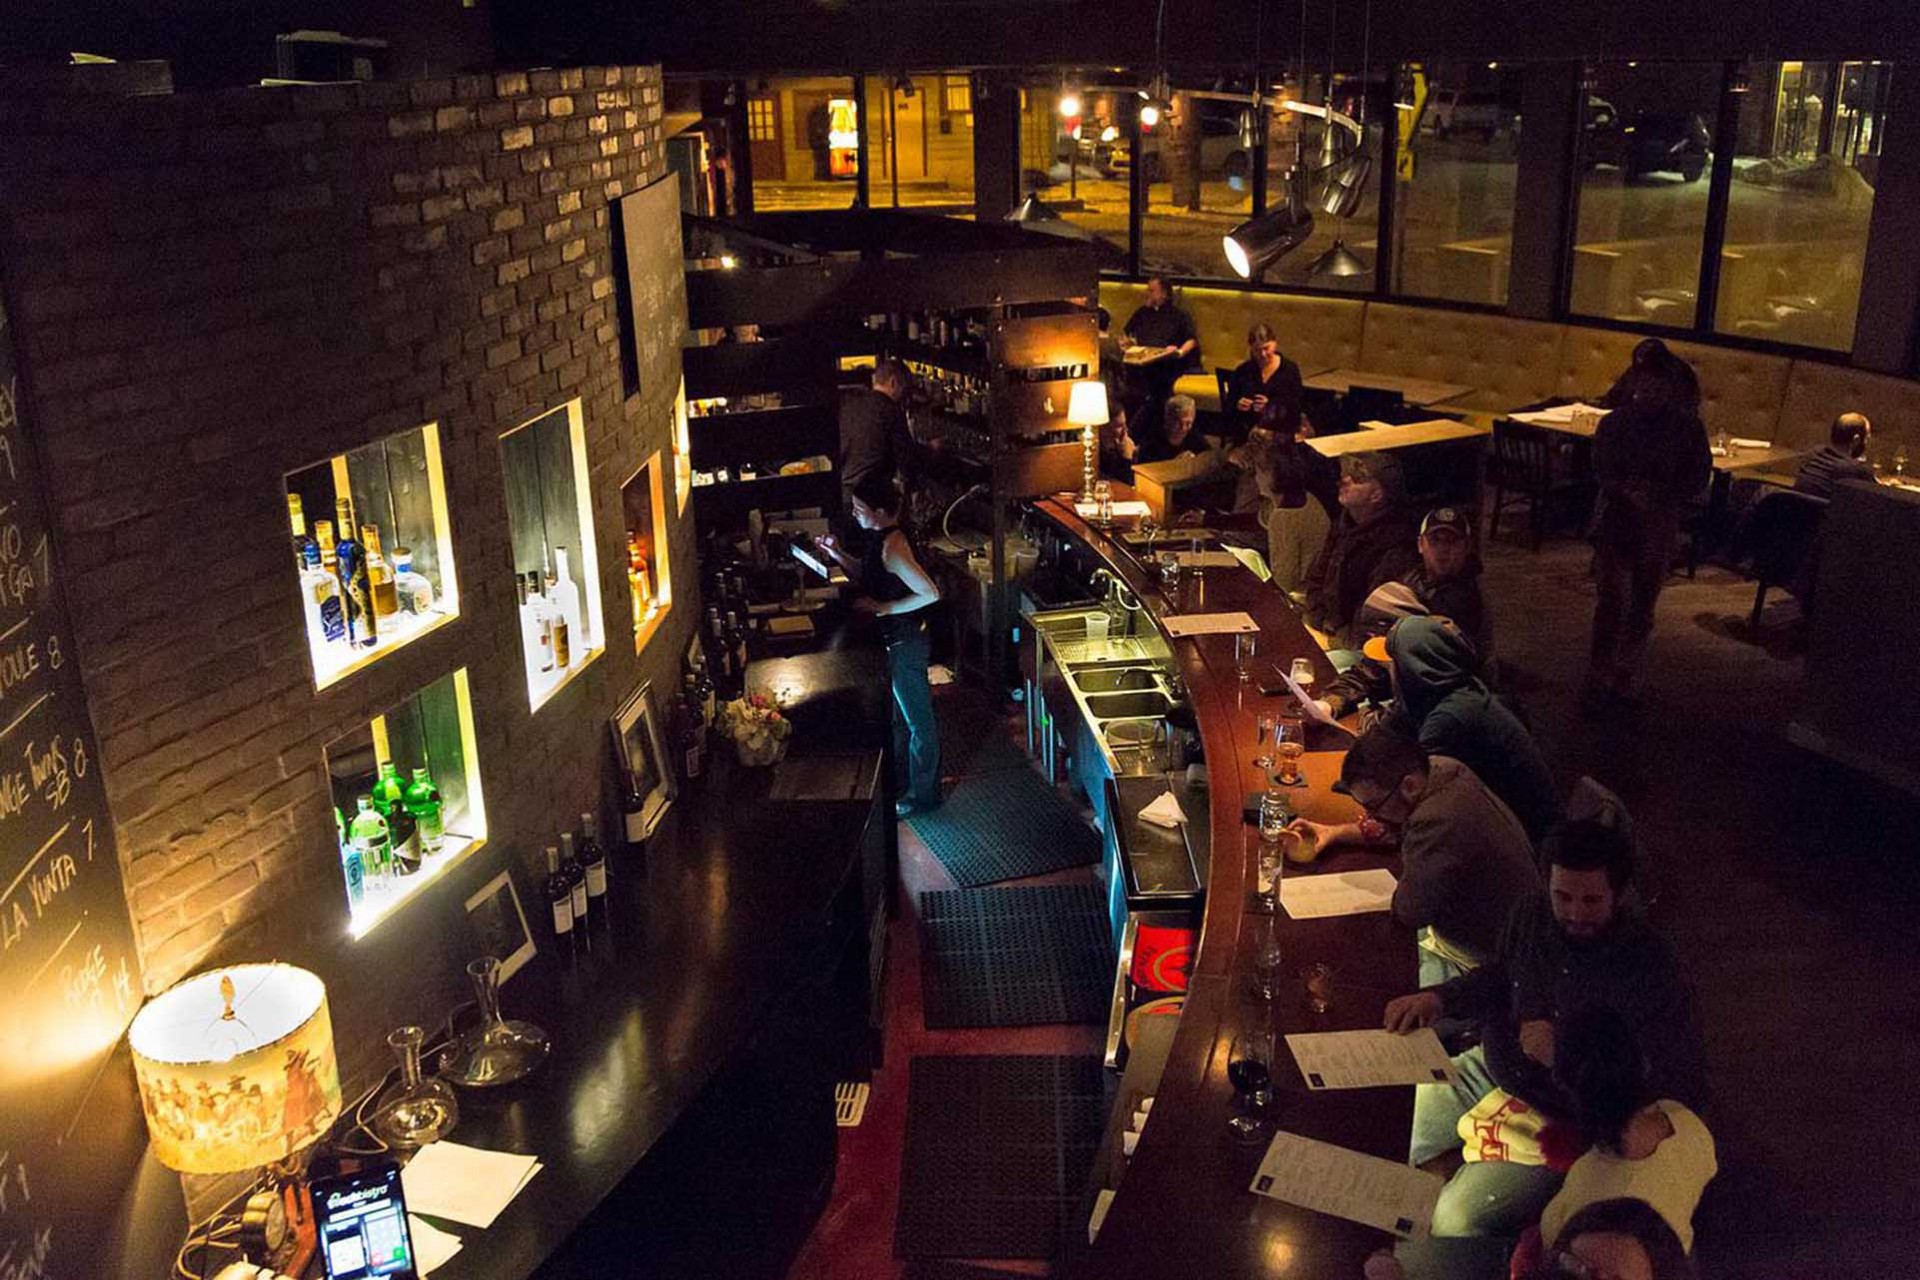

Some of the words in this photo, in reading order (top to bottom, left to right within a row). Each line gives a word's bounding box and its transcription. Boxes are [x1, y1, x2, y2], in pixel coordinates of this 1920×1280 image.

[47, 635, 64, 670] 8
[74, 738, 86, 778] 8
[3, 902, 29, 949] LA
[27, 854, 77, 918] YUNTA
